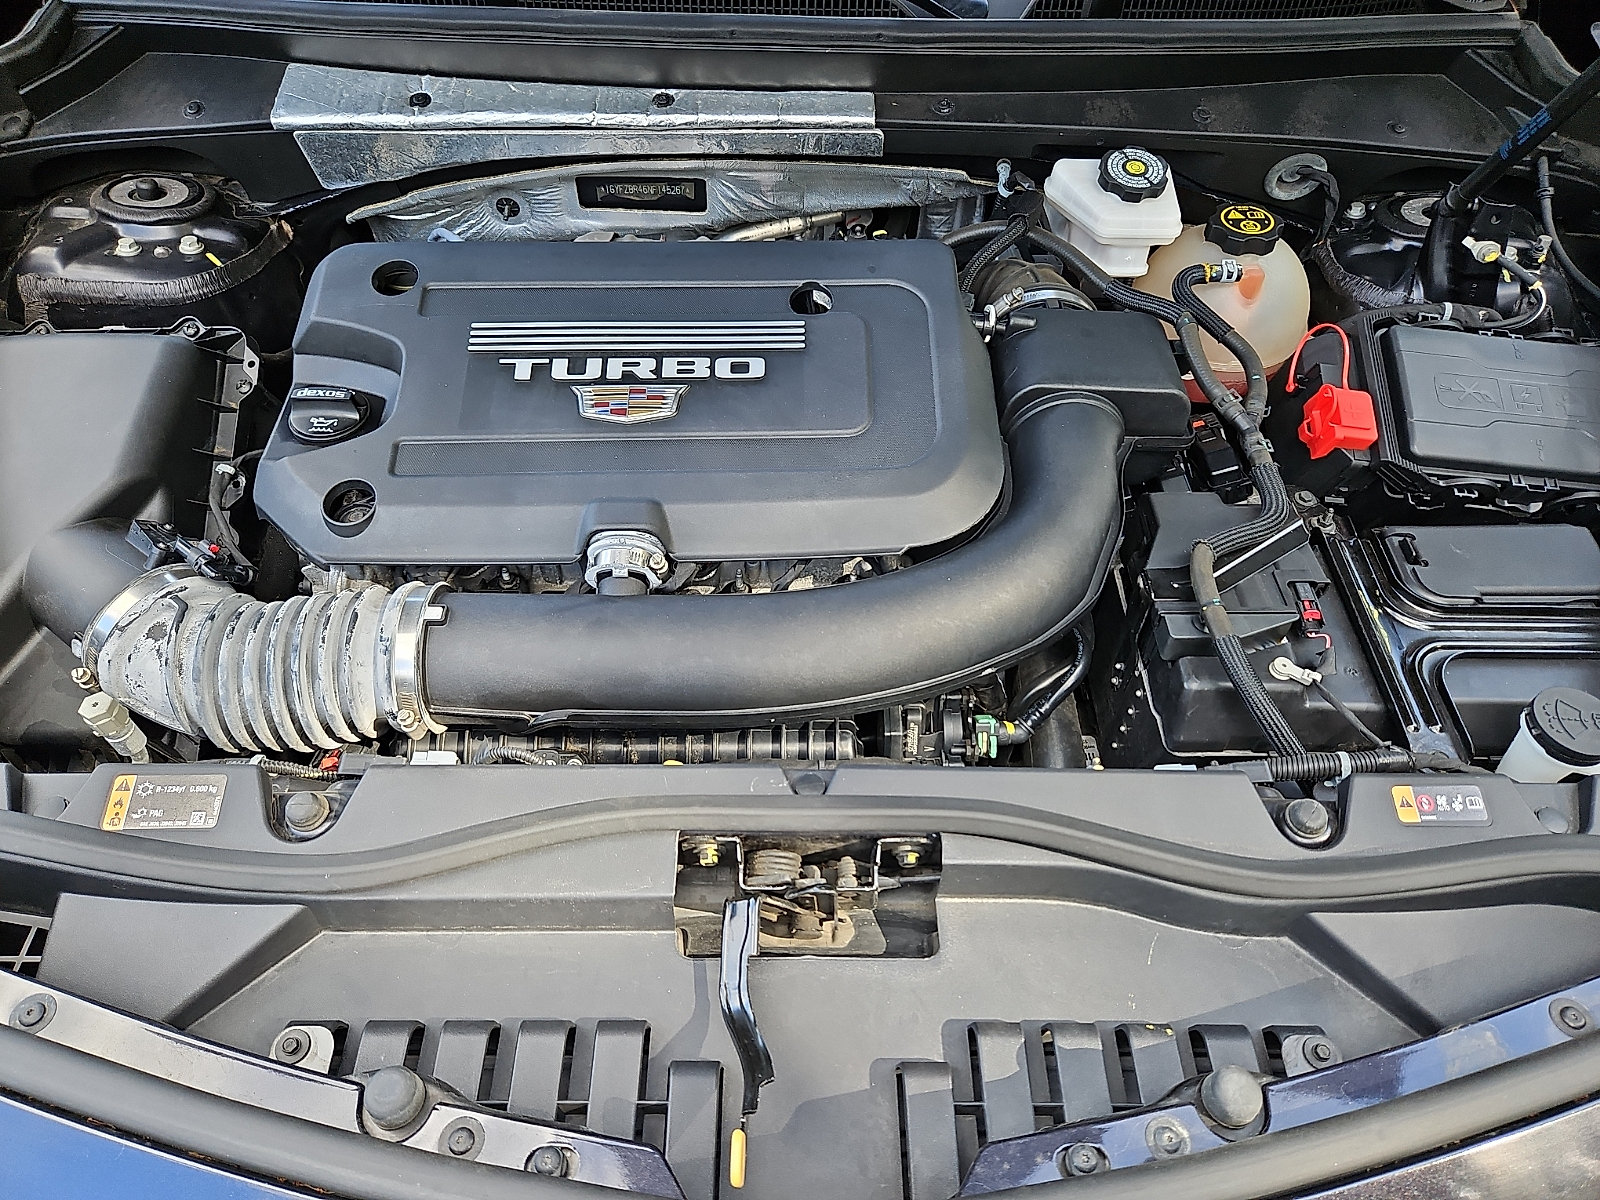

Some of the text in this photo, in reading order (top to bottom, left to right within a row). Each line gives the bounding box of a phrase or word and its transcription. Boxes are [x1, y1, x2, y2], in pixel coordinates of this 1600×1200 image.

[498, 357, 766, 381] TURBO
[296, 387, 346, 398] dexos
[155, 785, 187, 794] R-1234yf
[208, 784, 218, 794] kg
[149, 809, 164, 818] PAG
